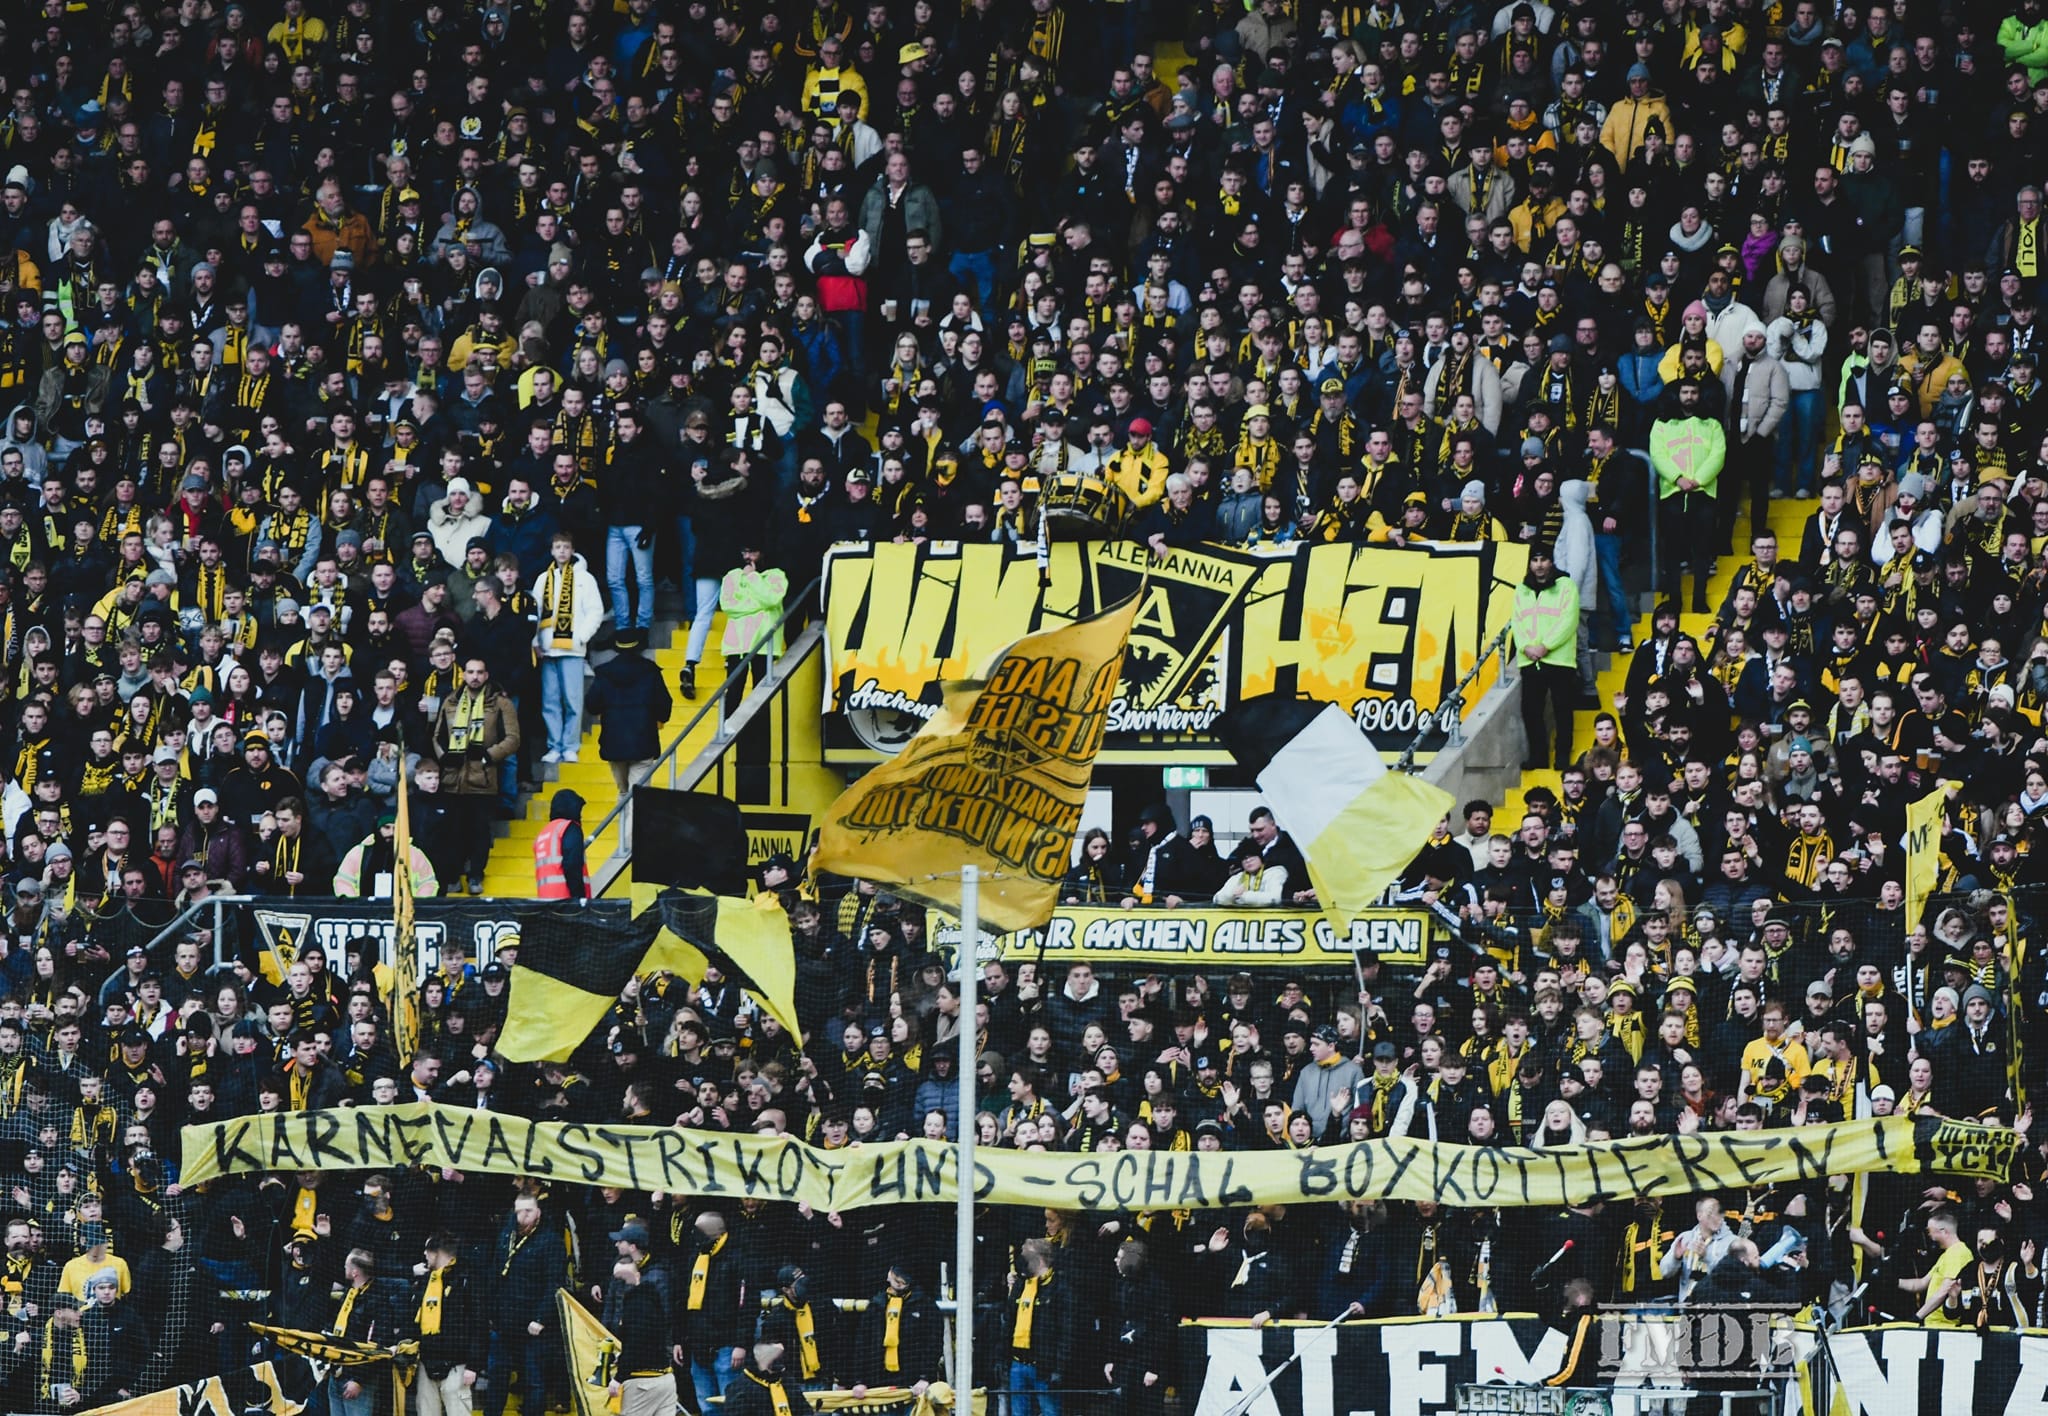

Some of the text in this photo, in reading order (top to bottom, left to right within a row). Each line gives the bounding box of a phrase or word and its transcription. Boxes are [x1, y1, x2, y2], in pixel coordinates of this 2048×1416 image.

[2022, 222, 2035, 267] VOLI
[1098, 540, 1234, 587] ALEMANNIA
[848, 679, 939, 720] Aachene
[1353, 698, 1416, 732] 1900
[750, 836, 794, 859] ANNIA
[1083, 918, 1206, 952] AACHEN
[1212, 918, 1306, 952] ALLES
[1313, 918, 1422, 952] GBEN!
[214, 1108, 845, 1205] KARNEVALSTRIKOT
[870, 1143, 997, 1201] UND
[1297, 1127, 1838, 1205] BOYKOTTIEREN
[1193, 1321, 2048, 1416] ALEMANI
